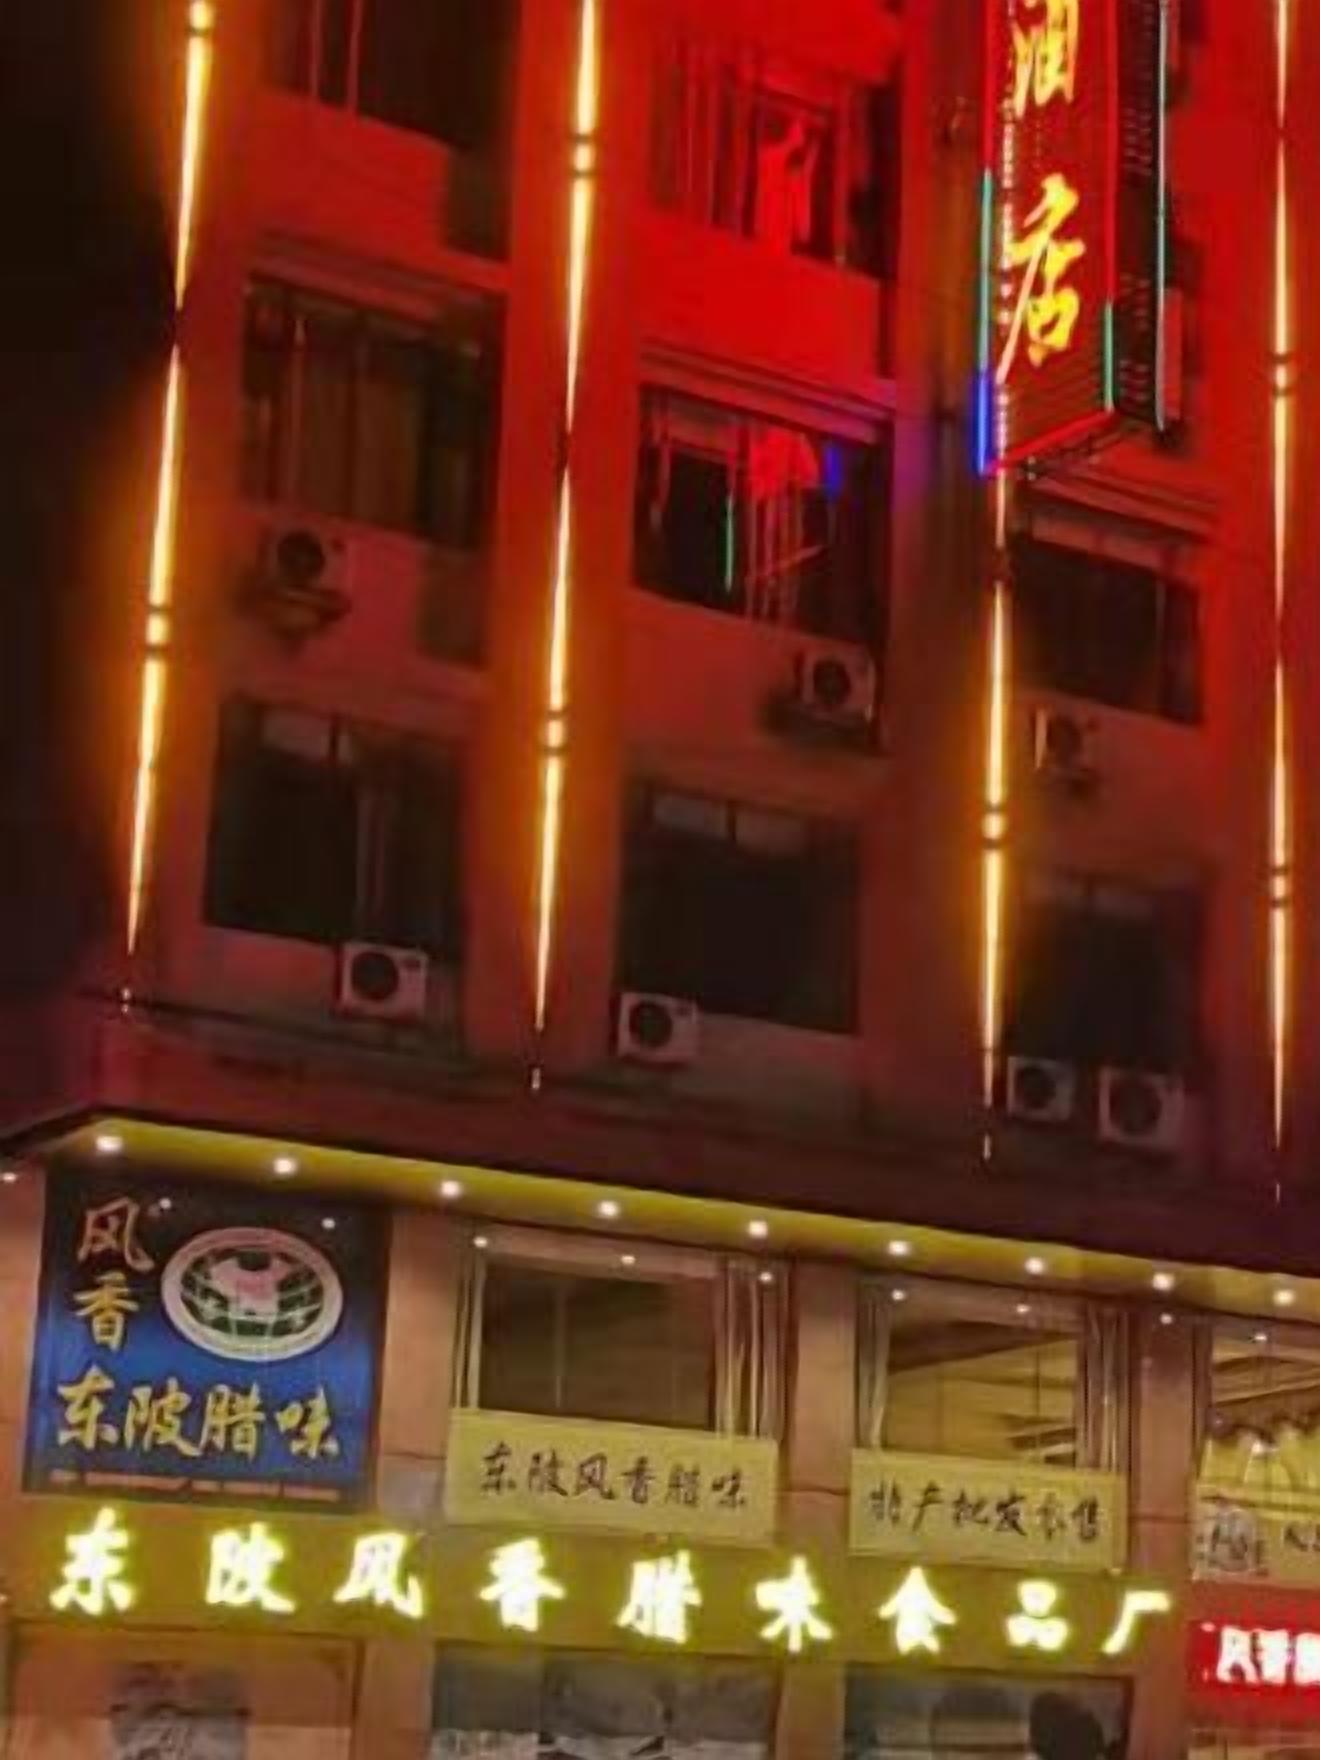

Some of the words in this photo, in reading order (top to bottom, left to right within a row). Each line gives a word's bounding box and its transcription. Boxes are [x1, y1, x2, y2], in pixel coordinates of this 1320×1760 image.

[73, 1197, 154, 1353] 风香
[56, 1364, 341, 1461] 东陂腊味
[481, 1441, 746, 1507] 东陂风香腊味
[48, 1506, 1172, 1656] 东陂风香腊味食品厂
